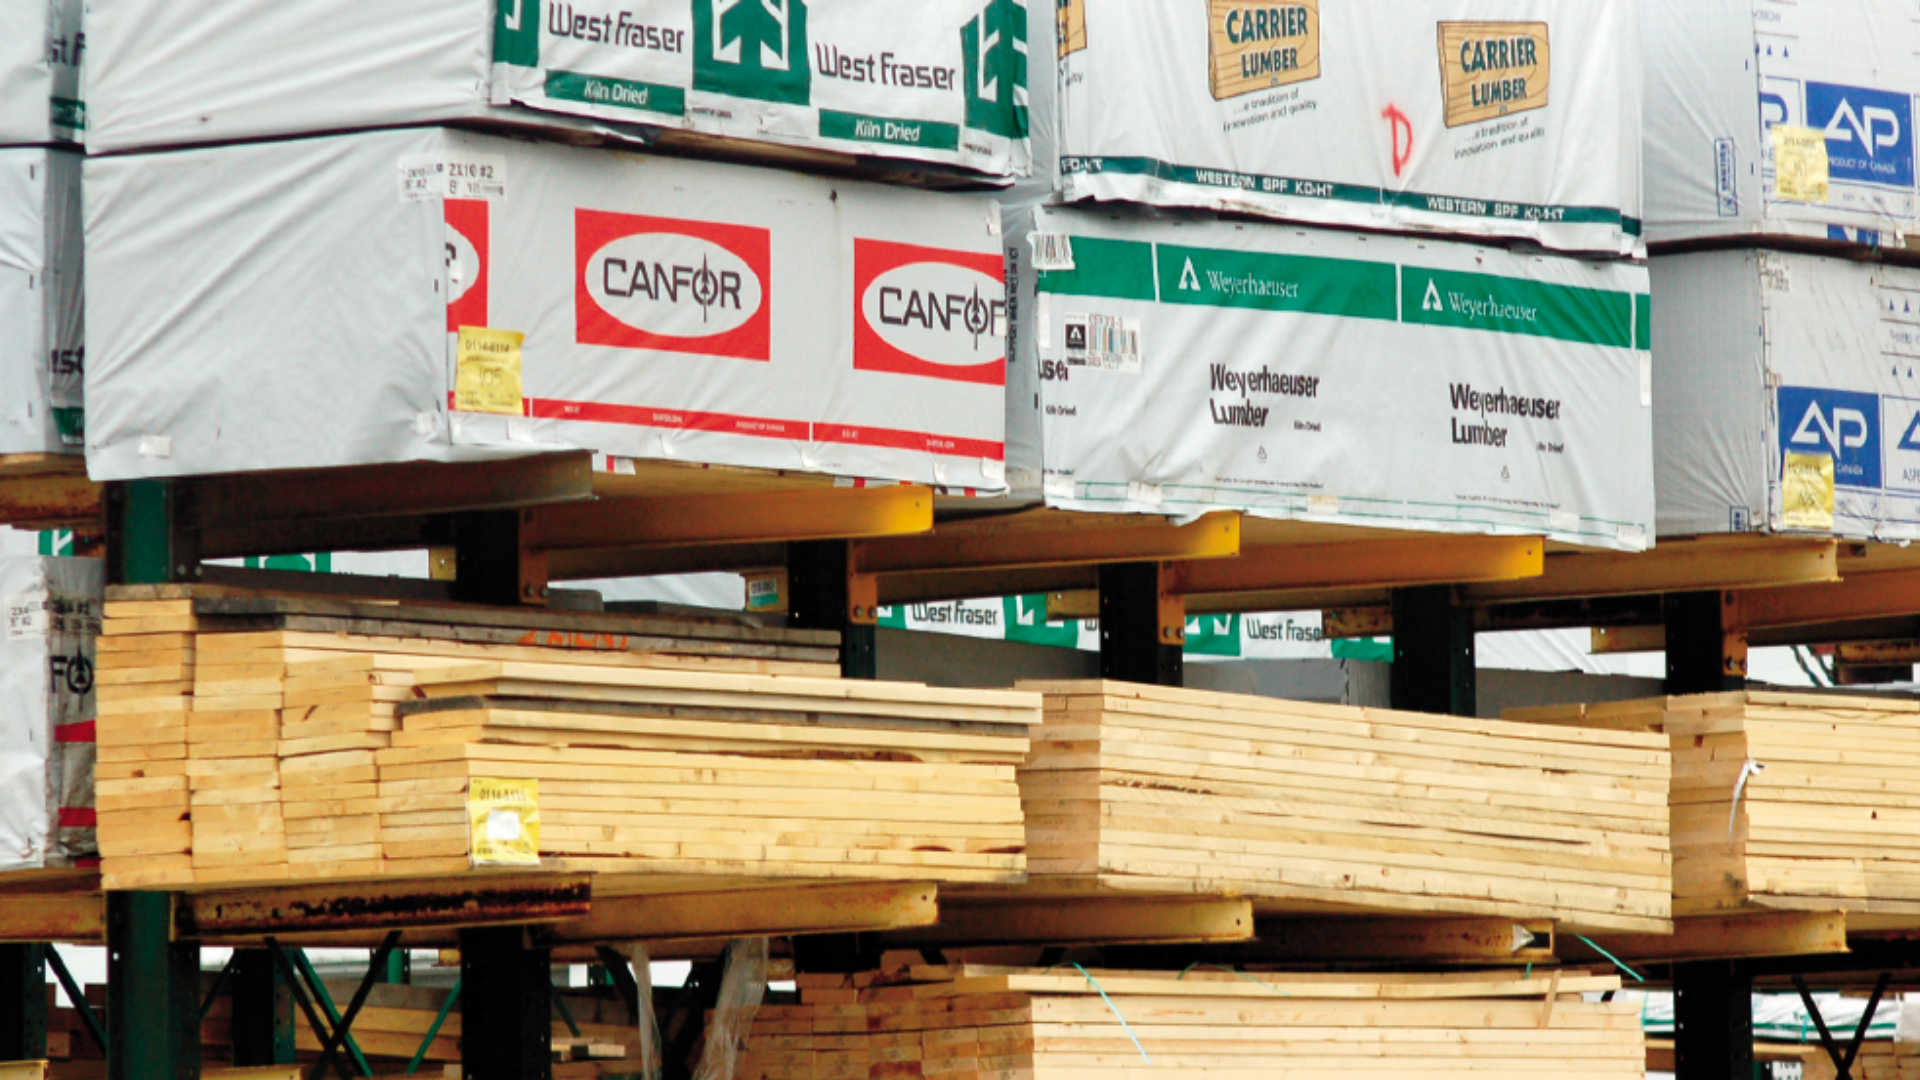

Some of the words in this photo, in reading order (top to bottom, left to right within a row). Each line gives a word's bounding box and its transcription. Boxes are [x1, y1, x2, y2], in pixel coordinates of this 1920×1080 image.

[548, 1, 613, 44] West
[614, 10, 686, 53] Fraser
[1225, 6, 1309, 45] CARRIER
[814, 42, 876, 83] West
[880, 51, 956, 91] Fraser
[1241, 48, 1299, 79] LUMBER
[1459, 37, 1538, 73] CARRIER
[583, 80, 609, 99] Kiln
[611, 83, 648, 105] Dried
[1471, 77, 1528, 107] LUMBER
[855, 119, 881, 138] Kiln
[883, 122, 921, 142] Dried
[1380, 101, 1414, 178] D
[1195, 169, 1256, 190] WESTERN
[1262, 176, 1288, 193] SPF
[1426, 195, 1487, 215] WESTERN
[1493, 202, 1519, 218] SPF
[603, 255, 742, 315] CANFOR
[1205, 269, 1299, 299] Weyerhaeuser
[1447, 290, 1538, 323] Weyerhaeuser
[1209, 362, 1320, 399] Weyerhaeuser
[1209, 397, 1270, 428] Lumber
[1449, 382, 1561, 420] Weyerhaeuser
[1451, 416, 1509, 448] Lumber
[912, 602, 952, 622] West
[953, 600, 998, 626] Fraser
[1246, 618, 1283, 640] West
[1285, 618, 1327, 643] Frase
